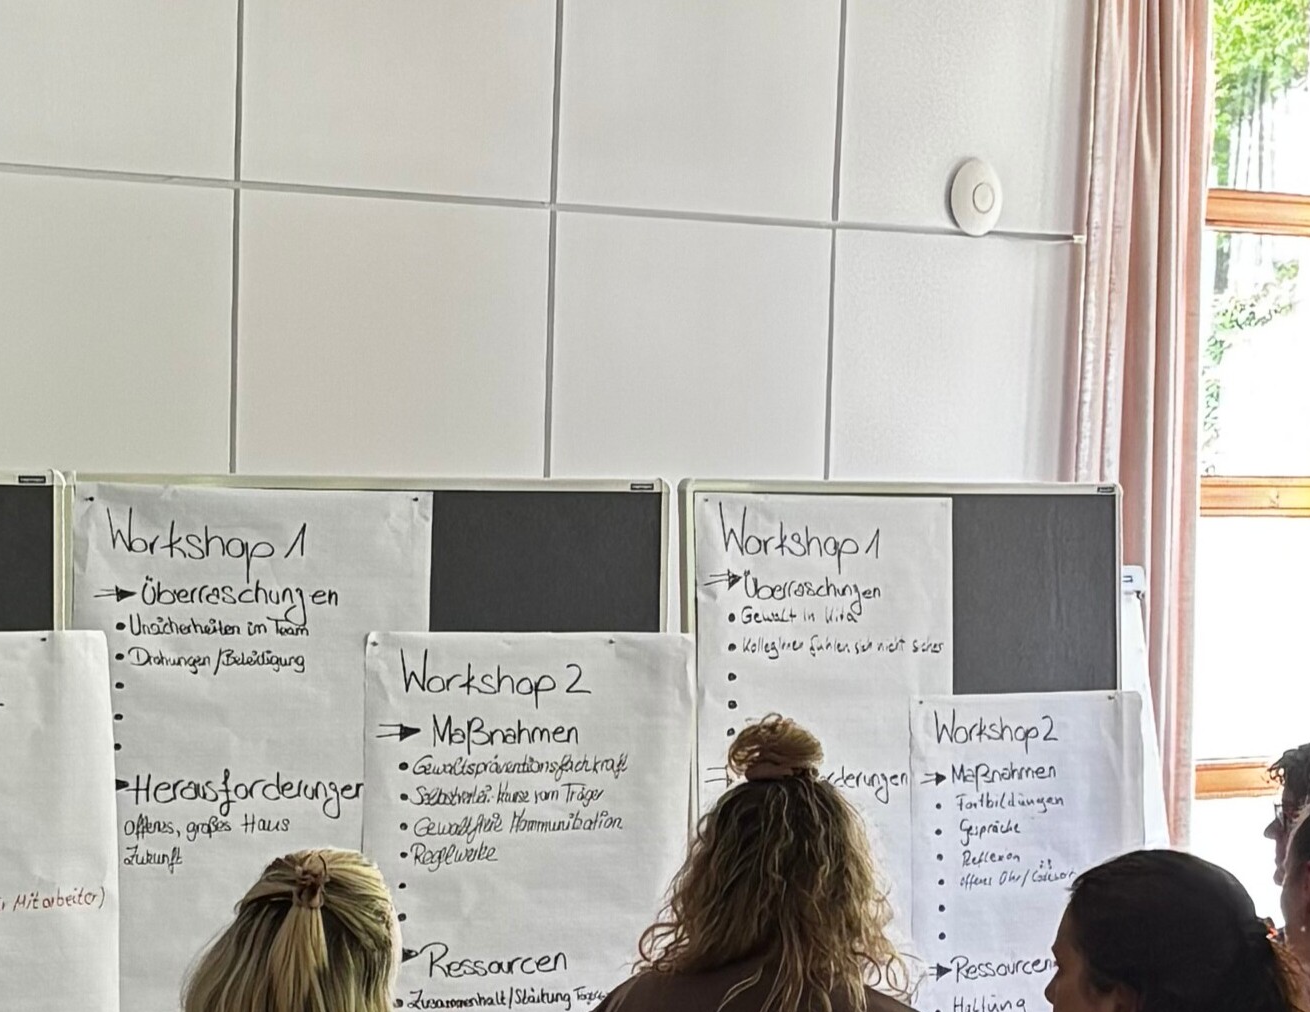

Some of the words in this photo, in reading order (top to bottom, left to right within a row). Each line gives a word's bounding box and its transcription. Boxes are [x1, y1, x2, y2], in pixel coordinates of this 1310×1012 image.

[106, 506, 275, 585] Workshop
[284, 522, 307, 559] 1
[717, 500, 860, 576] Workshop
[141, 575, 339, 627] Überraschungen
[743, 569, 882, 616] Überraschungen
[129, 612, 241, 637] Unsicherheiten
[247, 620, 268, 637] im
[266, 615, 310, 637] Team
[740, 605, 797, 625] Gewalt
[399, 648, 557, 709] Workshop
[565, 663, 592, 694] 2
[431, 713, 579, 755] Maßnahmen
[933, 708, 1039, 755] Workshop
[950, 762, 1057, 793] Maßnahmen
[240, 813, 291, 834] Haus
[123, 845, 184, 875] Zukunft
[418, 941, 568, 979] Ressourcen
